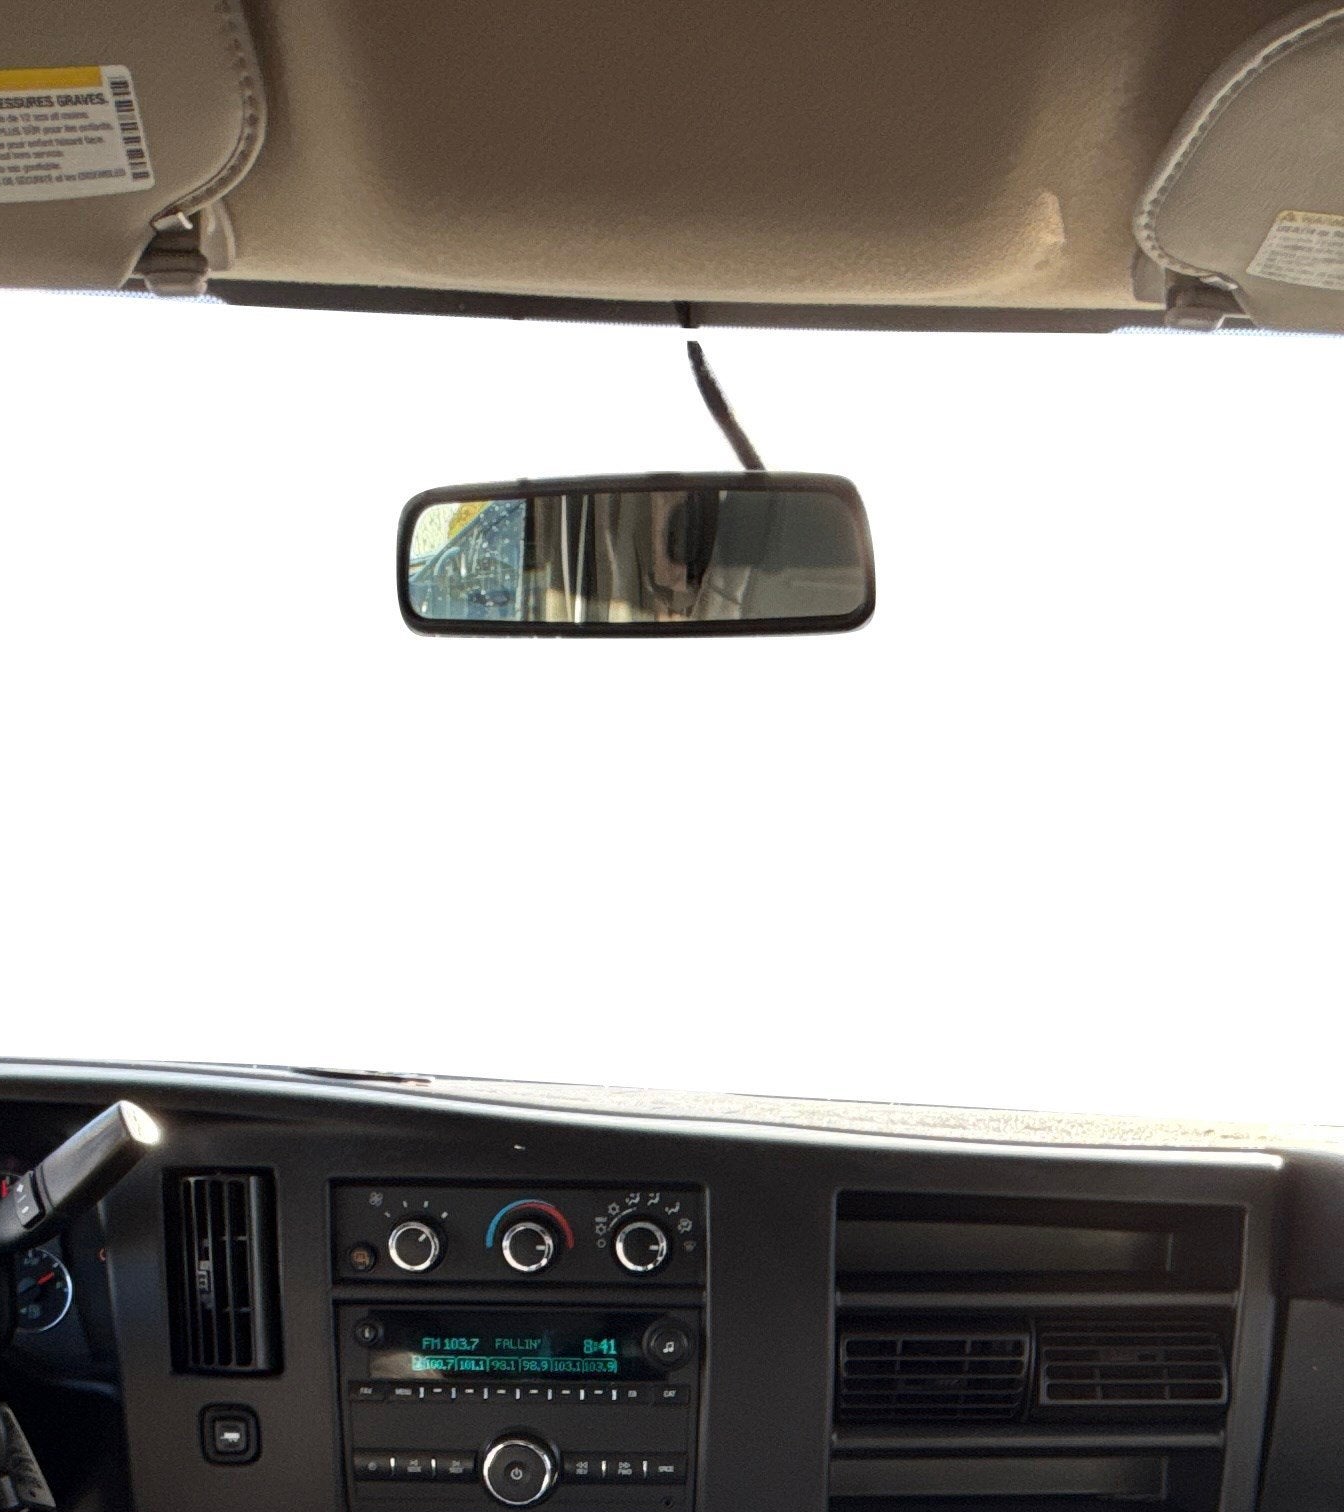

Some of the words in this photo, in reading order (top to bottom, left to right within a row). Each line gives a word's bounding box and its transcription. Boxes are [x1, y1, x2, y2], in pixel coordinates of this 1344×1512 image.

[421, 1337, 440, 1350] FM
[443, 1337, 479, 1350] 103.7
[495, 1337, 542, 1349] FALLIN'
[583, 1338, 617, 1355] 8:41
[460, 1360, 485, 1371] 101.1
[522, 1360, 549, 1371] 98.9
[553, 1360, 581, 1372] 103.1
